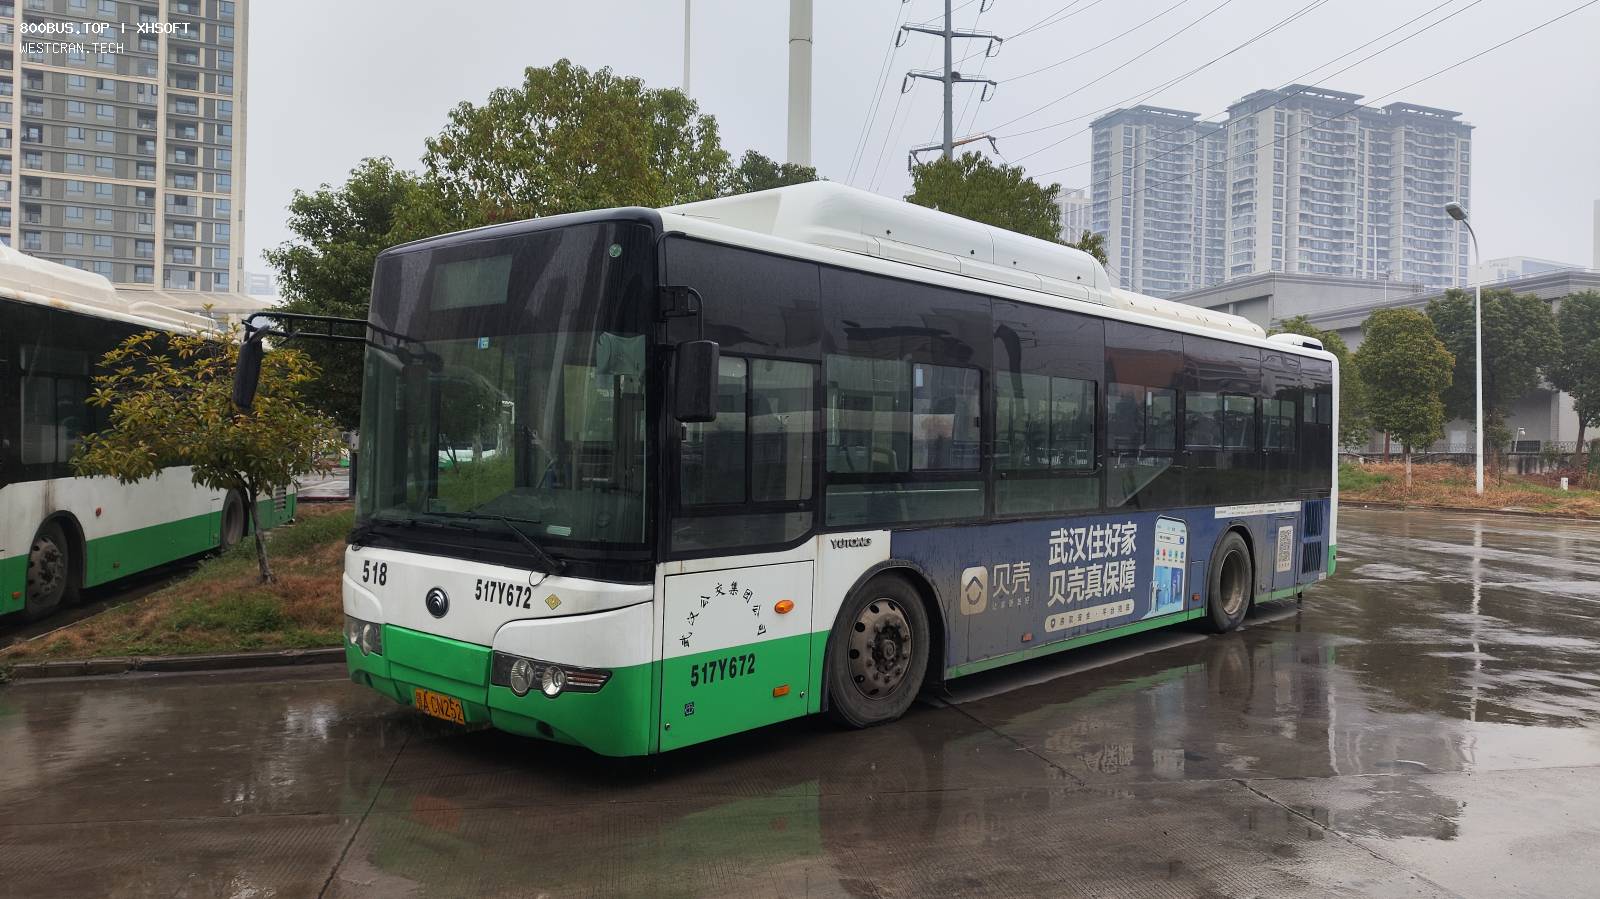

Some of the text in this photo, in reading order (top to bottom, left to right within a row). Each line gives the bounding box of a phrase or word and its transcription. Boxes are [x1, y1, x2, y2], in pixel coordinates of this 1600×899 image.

[830, 537, 873, 550] YUTONG
[1048, 521, 1138, 566] 武汉住好家
[361, 559, 388, 586] 518
[992, 560, 1032, 598] 贝壳
[1047, 559, 1137, 607] 贝壳真保障
[475, 578, 532, 609] 517Y672
[690, 653, 756, 687] 517Y672
